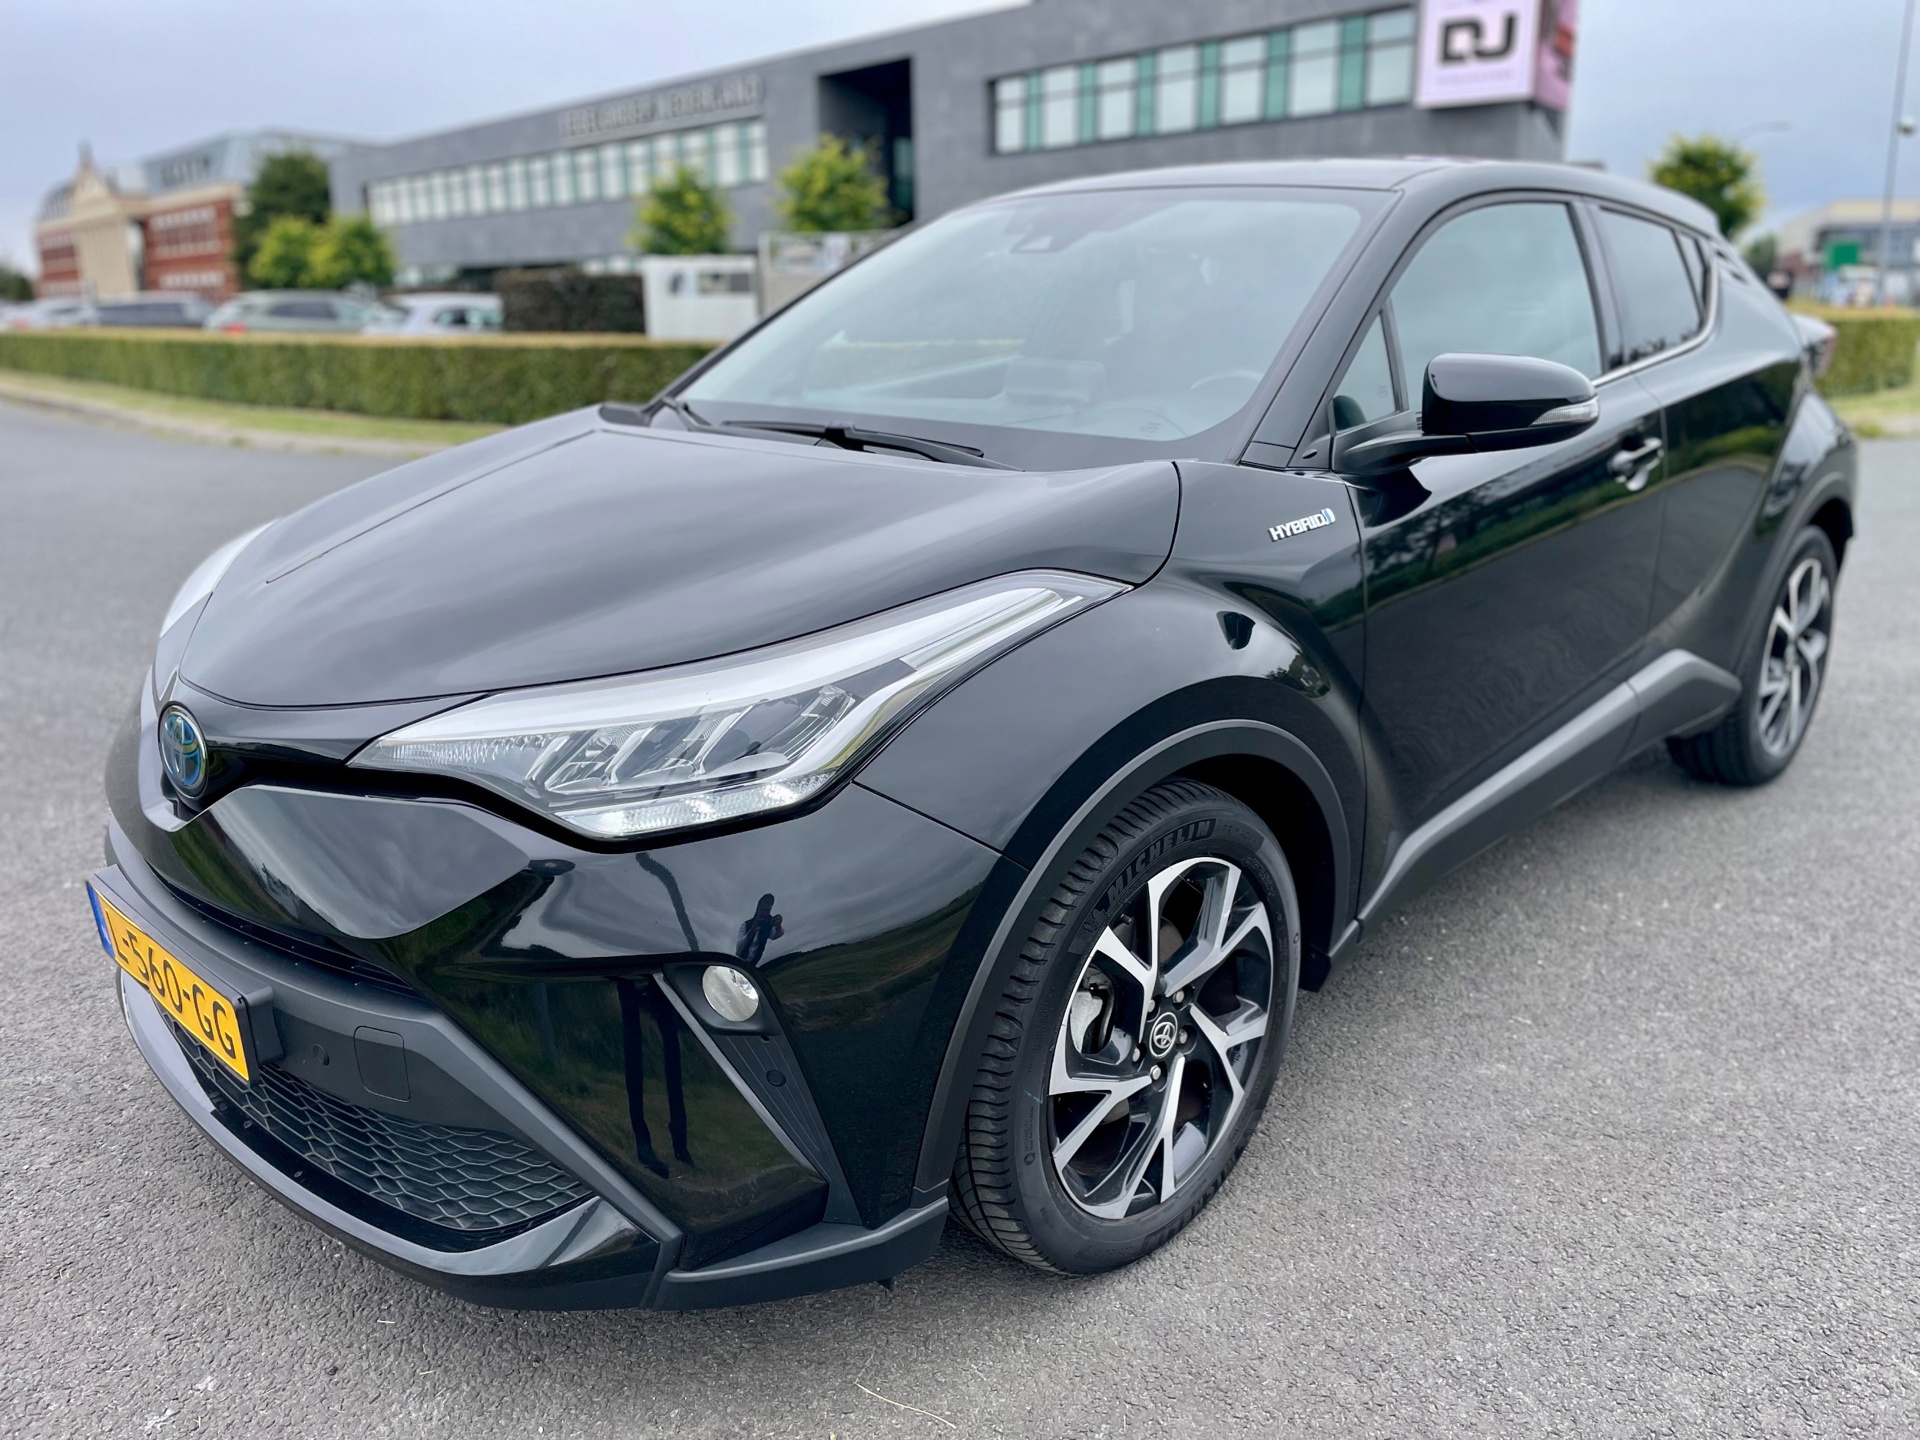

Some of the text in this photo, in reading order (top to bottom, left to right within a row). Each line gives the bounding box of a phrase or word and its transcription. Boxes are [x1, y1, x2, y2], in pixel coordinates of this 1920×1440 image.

[1268, 513, 1326, 541] HYBRID
[1107, 820, 1211, 905] MICHELIN
[106, 910, 236, 1059] L-560-GG
